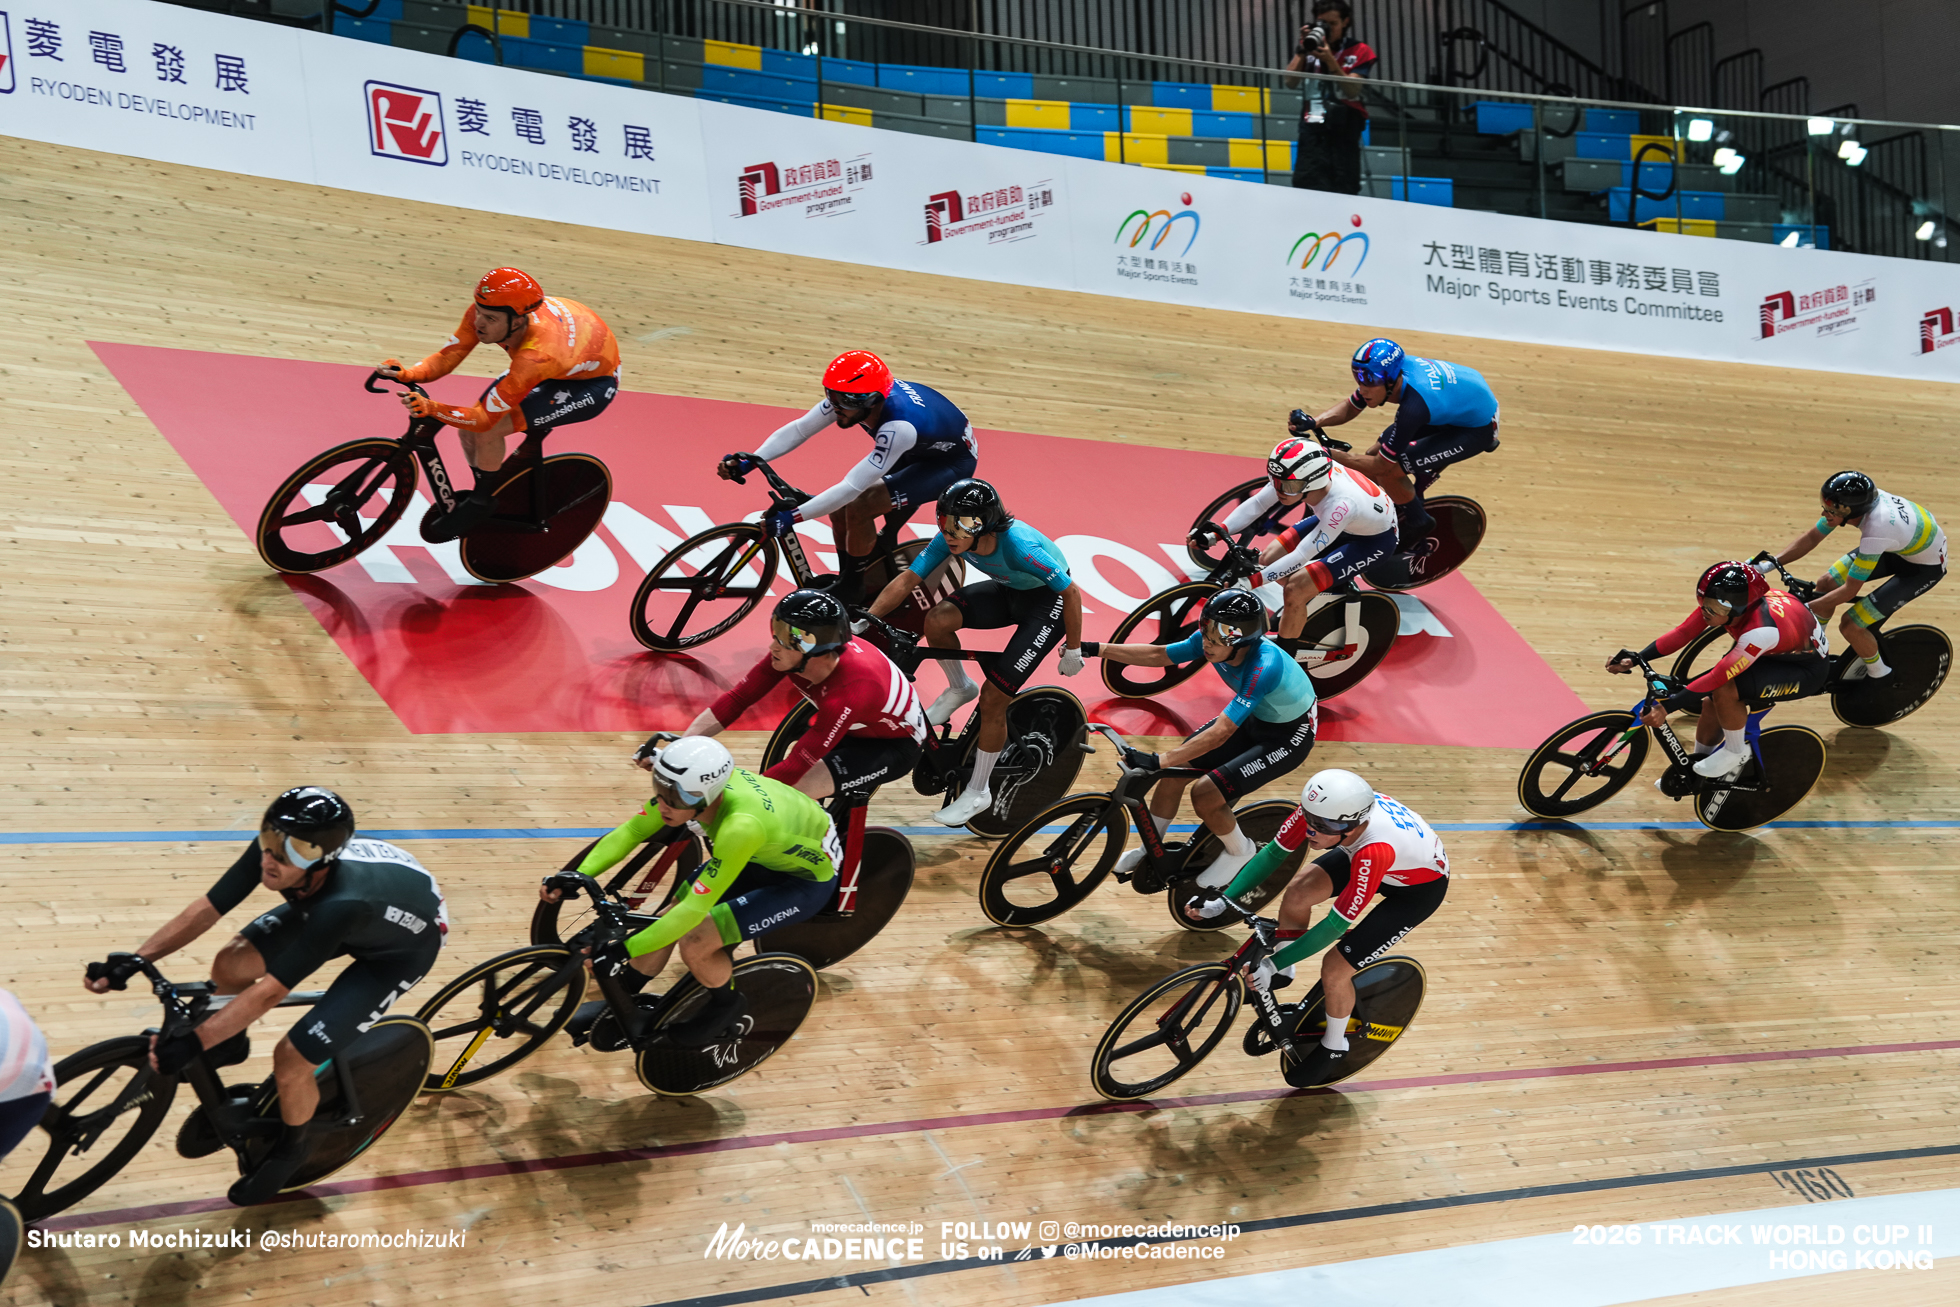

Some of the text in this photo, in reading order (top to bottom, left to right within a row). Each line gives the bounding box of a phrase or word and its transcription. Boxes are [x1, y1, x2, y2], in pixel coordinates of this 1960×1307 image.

[24, 17, 250, 95] 菱電發展
[31, 76, 256, 131] RYODEN DEVELOPMENT
[455, 96, 655, 162] 菱電發展
[461, 150, 661, 194] RYODEN DEVELOPMENT
[759, 184, 844, 212] Government-funded
[806, 196, 852, 215] programme
[943, 210, 1025, 238] Government-funded
[988, 220, 1033, 240] programme
[1117, 267, 1198, 286] Major Sports Events
[1422, 240, 1720, 298] 大型體育活動事務委員會
[1289, 288, 1368, 306] Major Sports Events
[1427, 274, 1724, 323] Major Sports Events Committee
[1776, 307, 1850, 334] Government-funded
[1817, 316, 1857, 335] programme
[533, 393, 595, 426] Staatsloterij
[872, 434, 888, 464] CIC
[1416, 445, 1464, 467] CASTELLI
[427, 457, 456, 514] KOGA
[1278, 562, 1302, 577] Cyclers
[1338, 550, 1384, 580] JAPAN
[1014, 648, 1037, 673] HONG
[1726, 655, 1750, 680] ANTA
[1760, 681, 1800, 699] CHINA
[823, 706, 852, 748] postnord
[1239, 757, 1266, 778] HONG
[1289, 722, 1311, 747] CHINA
[1660, 723, 1689, 766] INARELLO
[840, 766, 888, 791] postnord
[1347, 858, 1372, 918] PORTUGAL
[748, 905, 800, 935] SLOVENIA
[1357, 926, 1413, 968] PORTUGAL
[356, 975, 423, 1034] NZL
[1270, 1009, 1283, 1027] 18
[444, 1057, 468, 1087] MAVIC
[1781, 1167, 1855, 1203] 160
